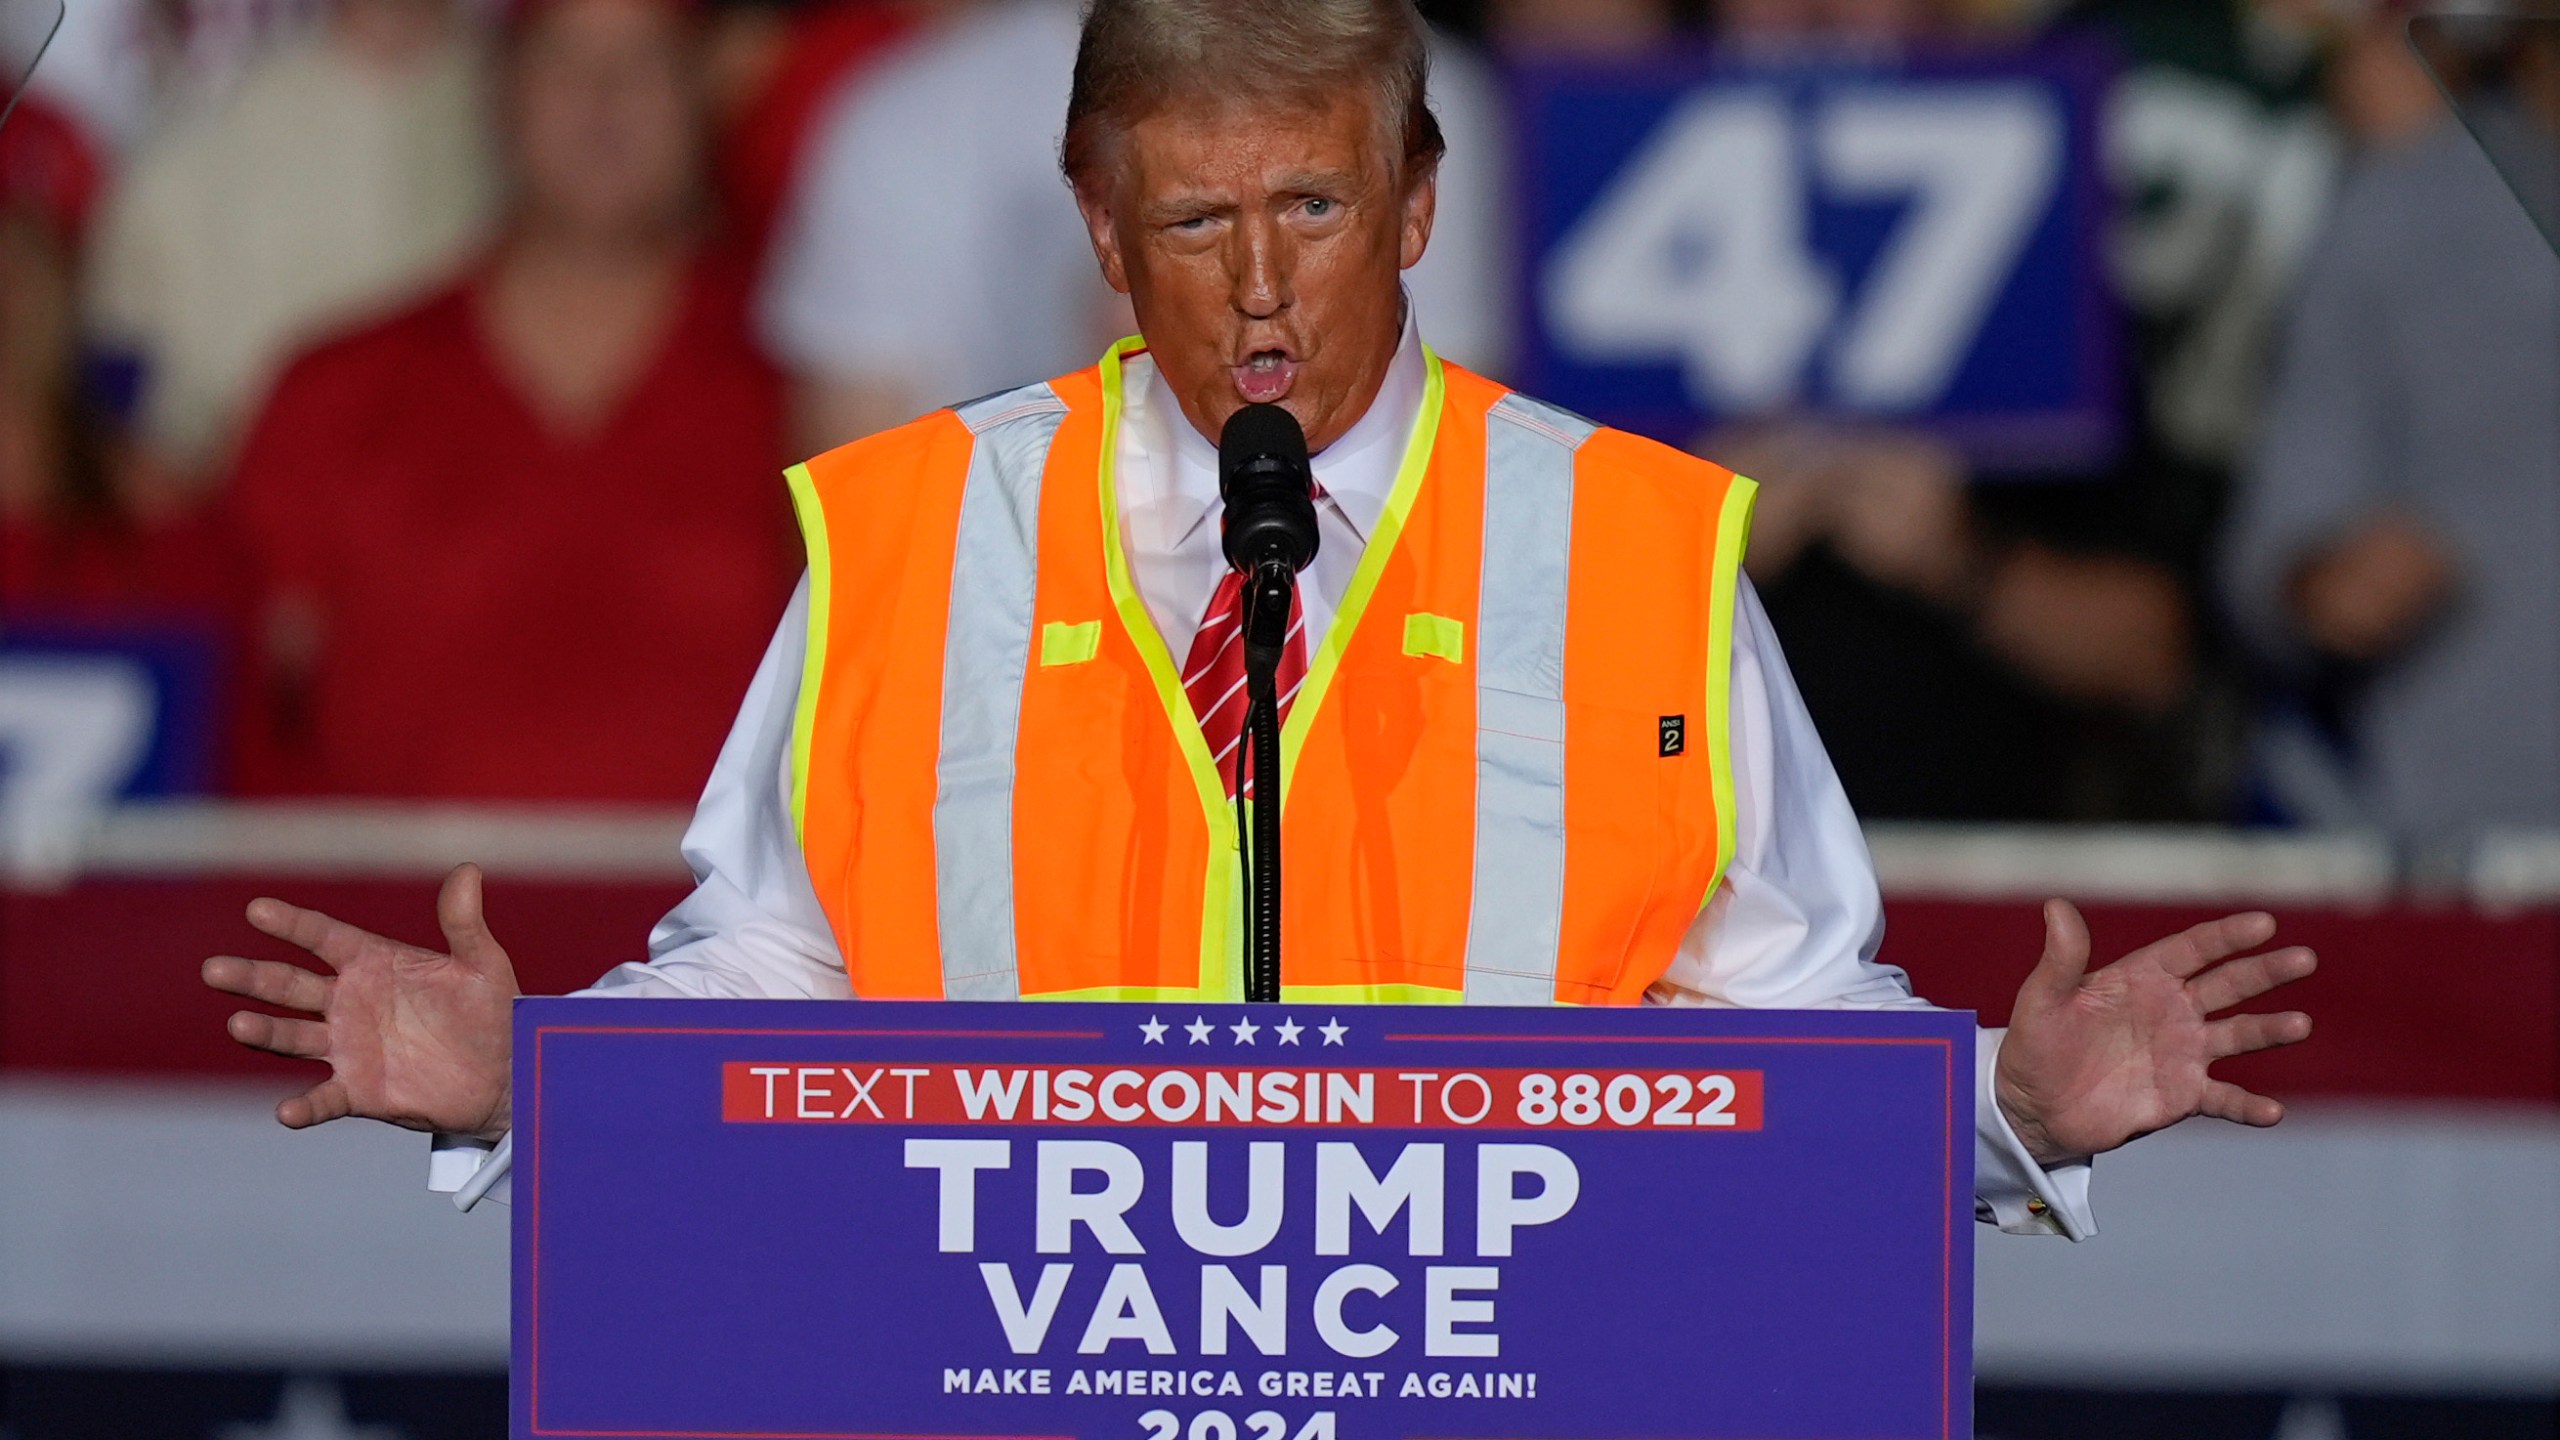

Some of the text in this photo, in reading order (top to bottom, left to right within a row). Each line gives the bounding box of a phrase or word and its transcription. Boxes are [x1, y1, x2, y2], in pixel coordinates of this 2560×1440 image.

[1543, 86, 2066, 410] 47
[1662, 719, 1681, 728] ANSI
[1664, 729, 1680, 752] 2
[750, 1067, 1736, 1126] TEXT WISCONSIN TO 88022
[904, 1138, 1580, 1257] TRUMP
[978, 1262, 1499, 1358] VANCE
[944, 1368, 1537, 1399] MAKE AMERICA GREAT AGAIN!
